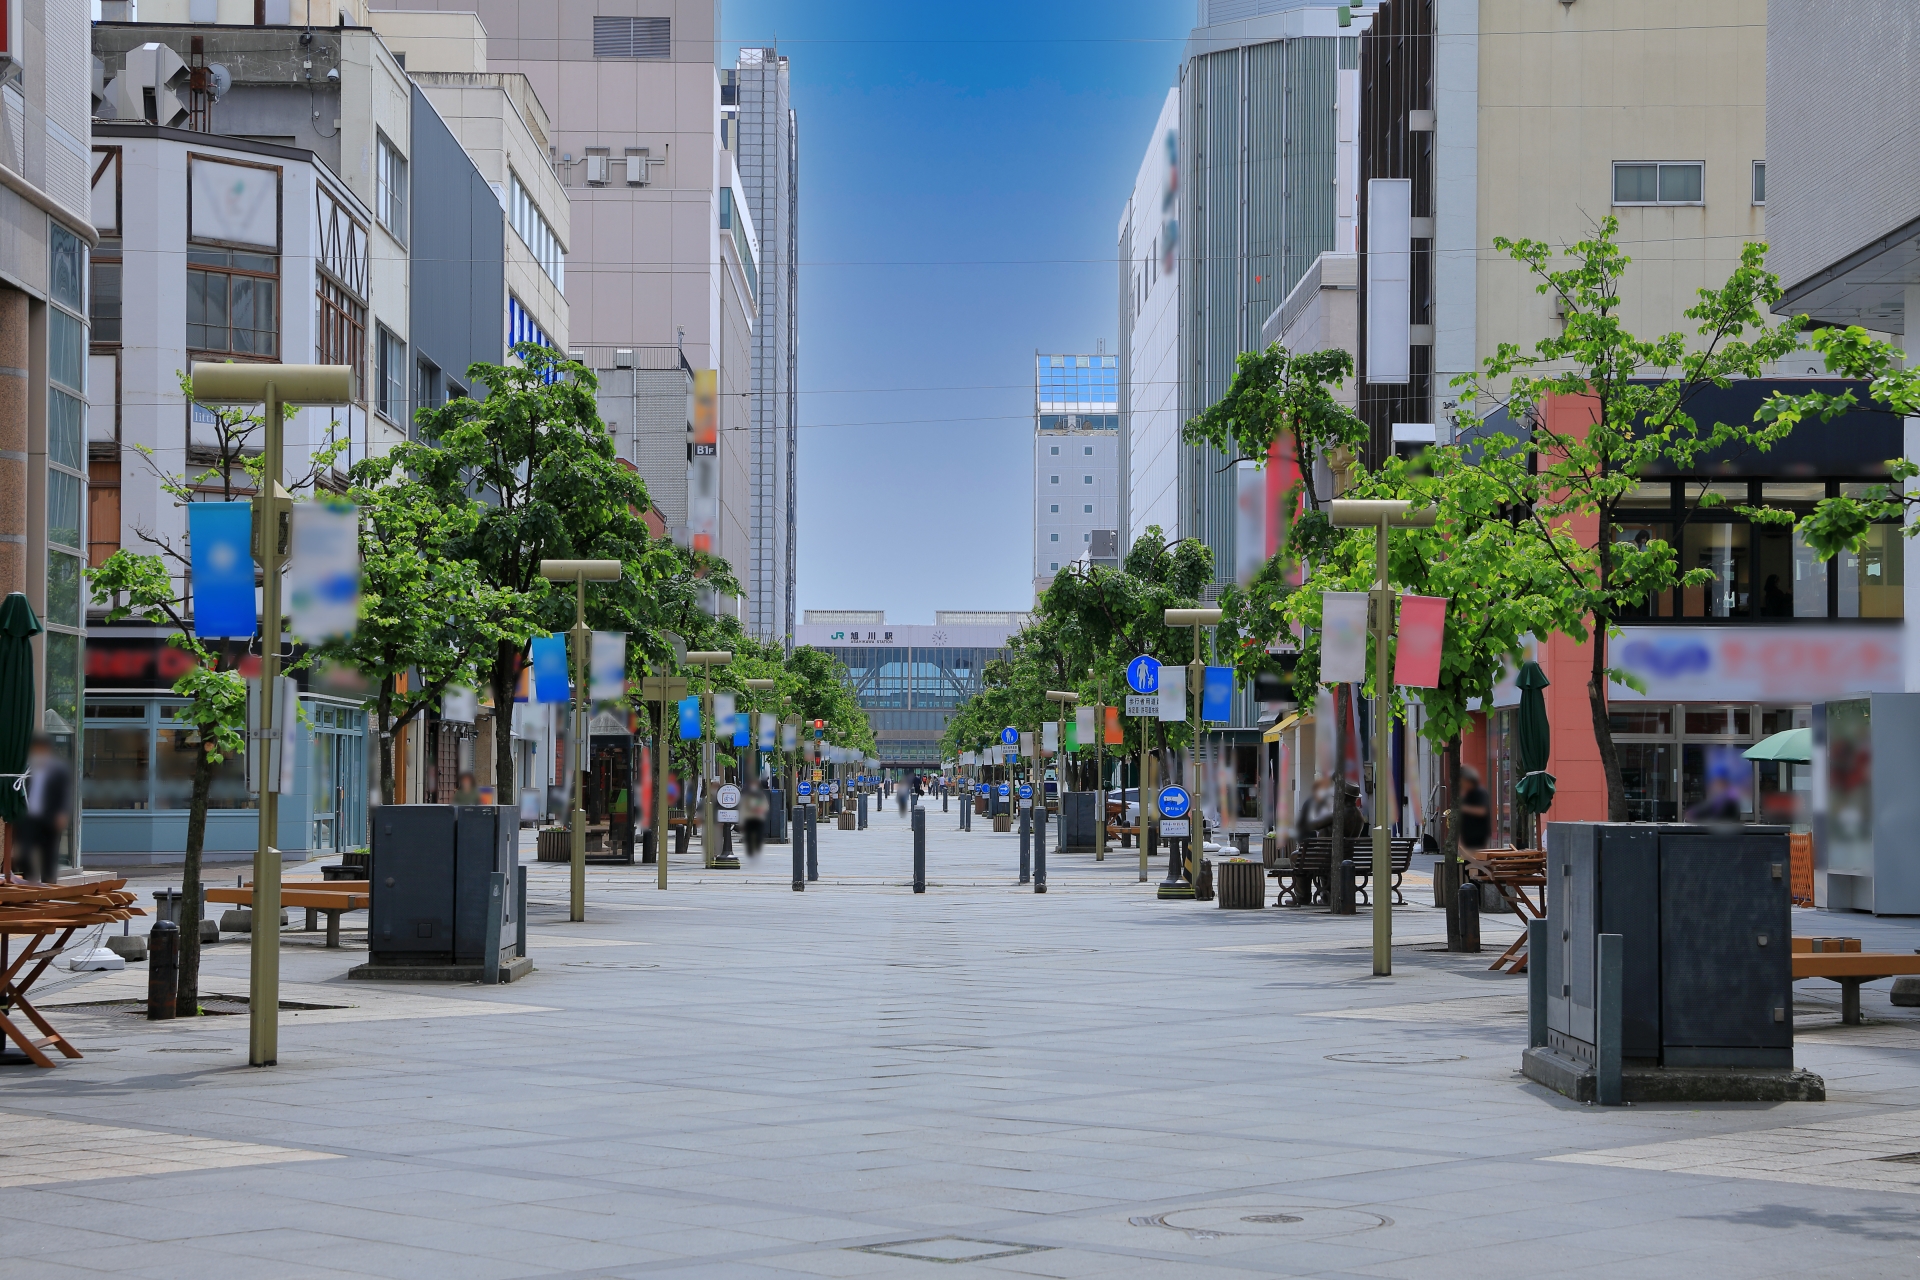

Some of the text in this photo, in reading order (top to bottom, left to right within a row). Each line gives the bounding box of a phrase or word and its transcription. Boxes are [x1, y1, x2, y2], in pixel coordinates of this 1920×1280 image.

[697, 445, 714, 455] B1F
[831, 632, 893, 640] JR 旭川駅
